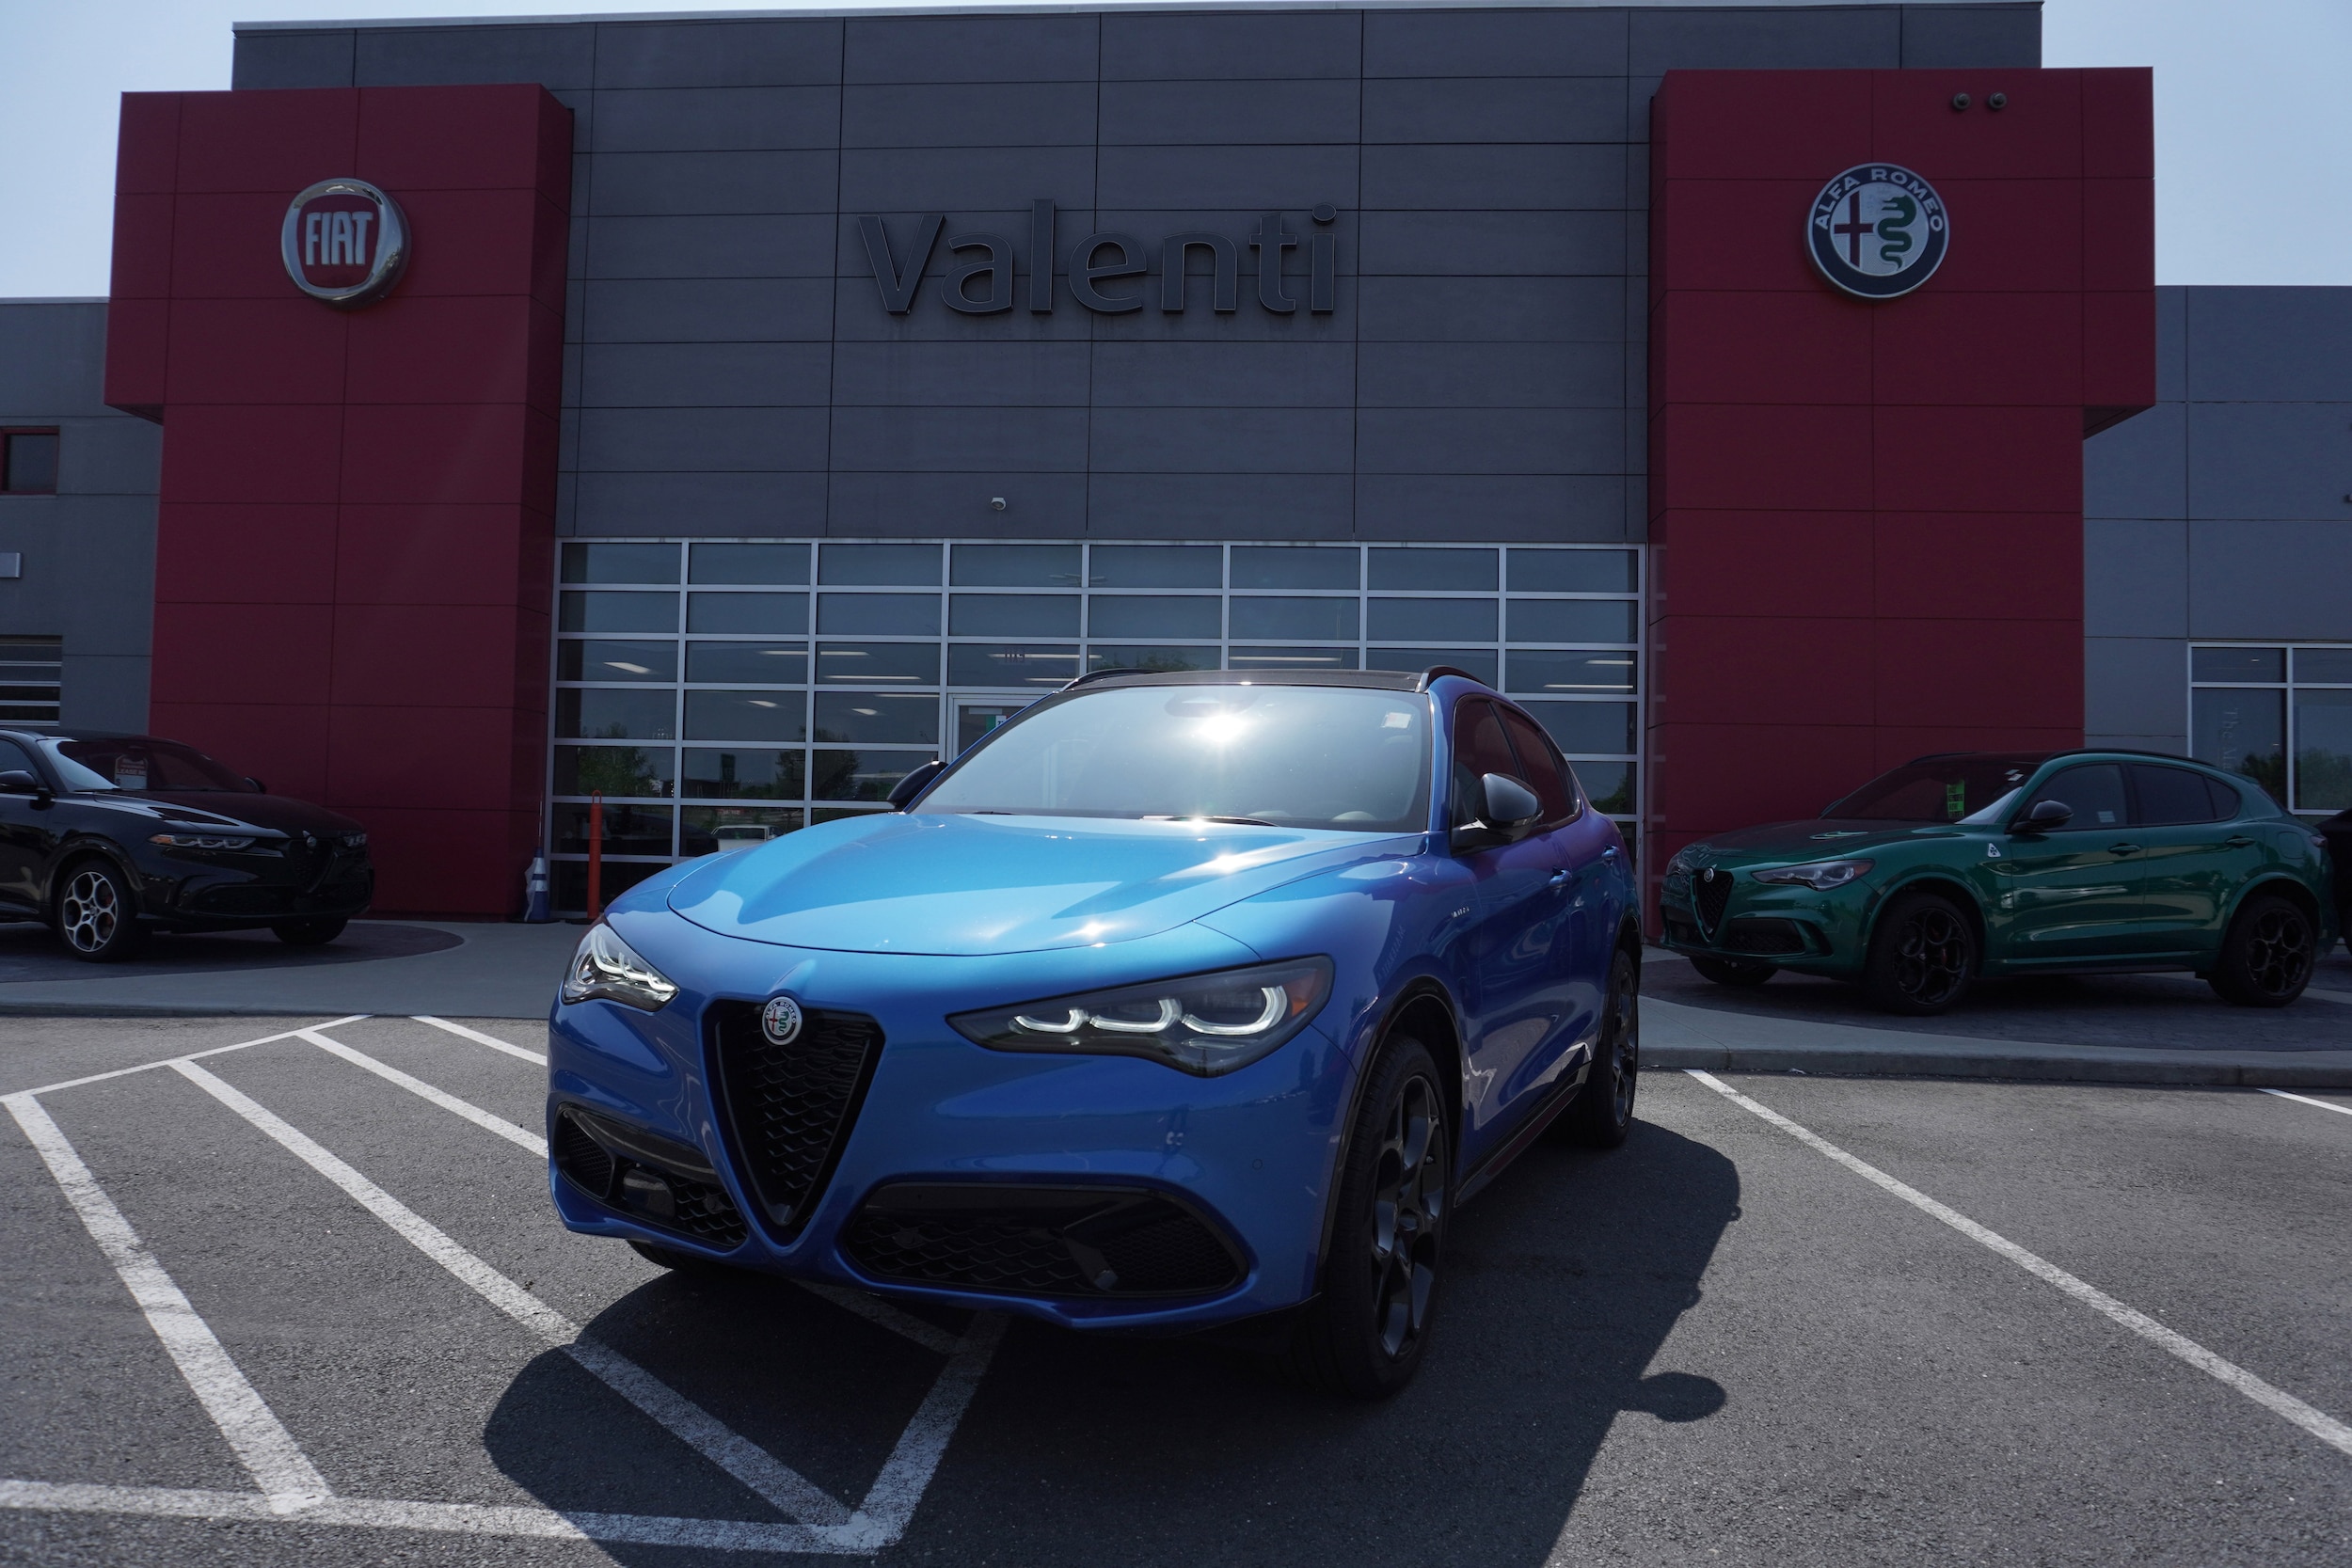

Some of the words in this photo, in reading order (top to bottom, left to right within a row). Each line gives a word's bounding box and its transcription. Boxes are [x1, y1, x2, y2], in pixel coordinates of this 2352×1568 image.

[1815, 176, 1861, 230] ALFA
[1871, 168, 1944, 231] ROMEO
[305, 211, 373, 266] FIAT
[856, 198, 1337, 314] Valenti
[780, 1001, 796, 1024] ROMEO
